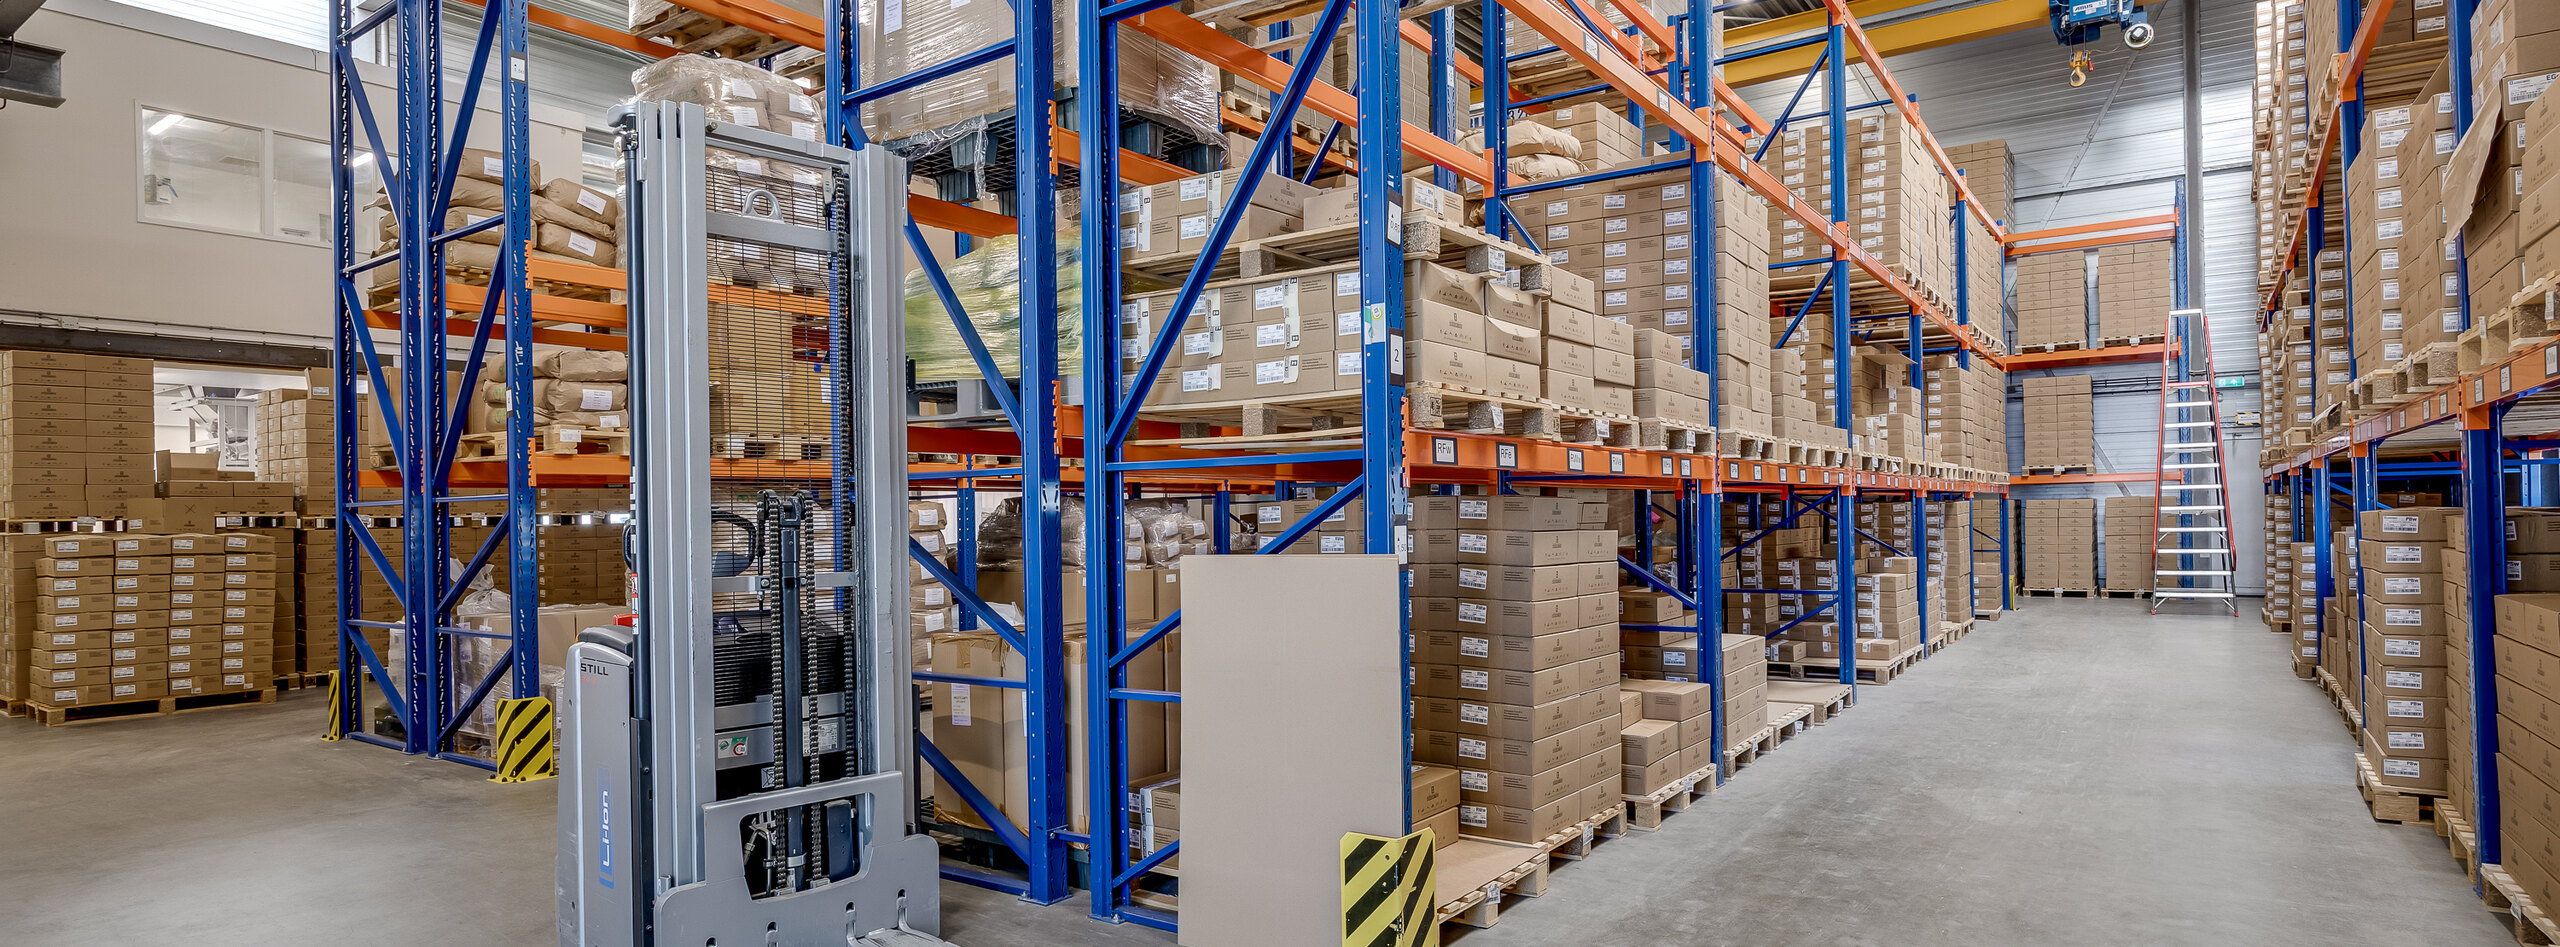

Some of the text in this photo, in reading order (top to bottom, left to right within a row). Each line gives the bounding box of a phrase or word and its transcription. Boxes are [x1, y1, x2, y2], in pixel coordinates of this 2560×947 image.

[1394, 348, 1399, 362] 2
[1437, 443, 1452, 455] RFw
[1500, 448, 1512, 459] RFe
[581, 662, 609, 676] STILL
